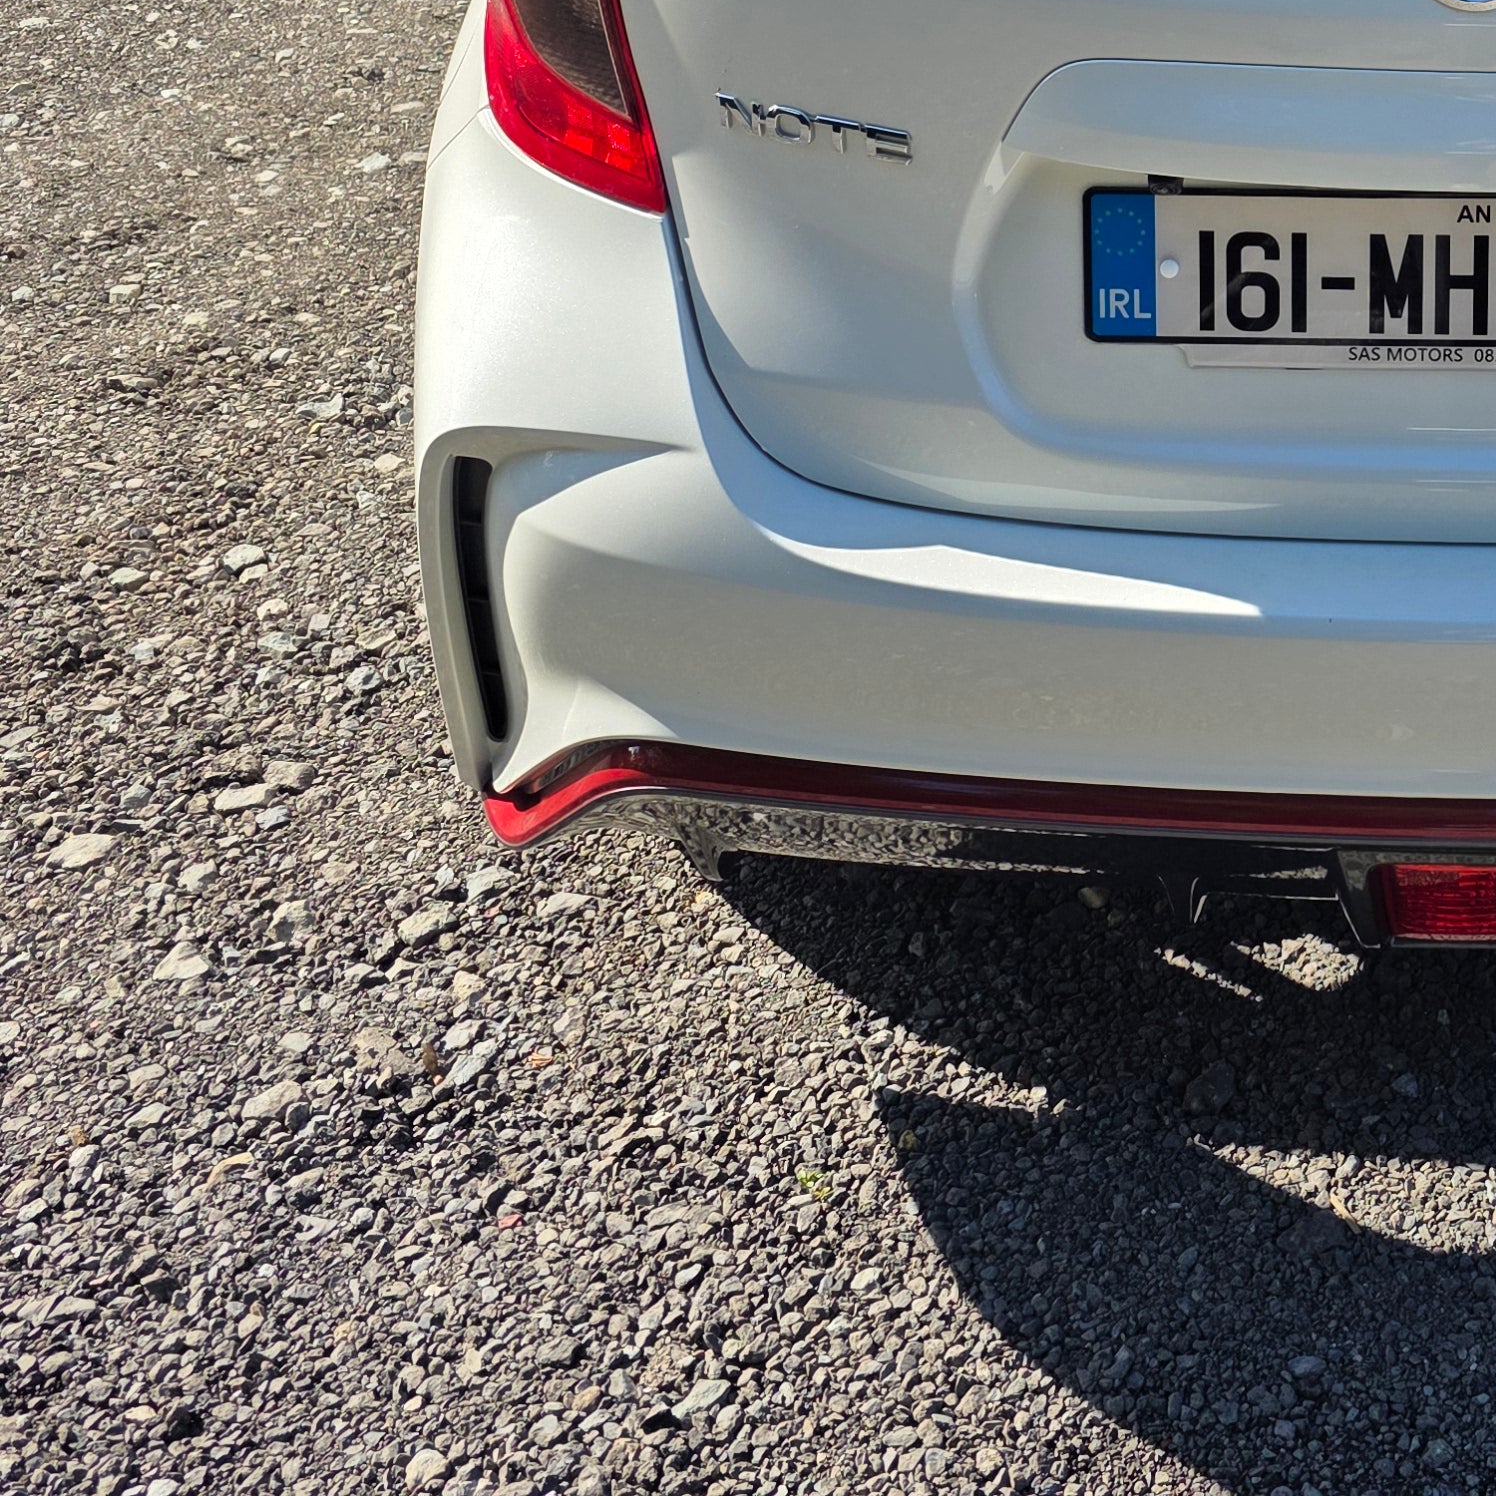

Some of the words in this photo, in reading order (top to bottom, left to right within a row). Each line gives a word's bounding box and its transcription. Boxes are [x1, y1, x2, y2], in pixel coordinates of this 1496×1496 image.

[714, 90, 914, 167] NOTE
[1456, 204, 1491, 224] AN
[1098, 288, 1153, 320] IRL
[1348, 346, 1381, 362] SAS
[1386, 347, 1464, 363] MOTORS
